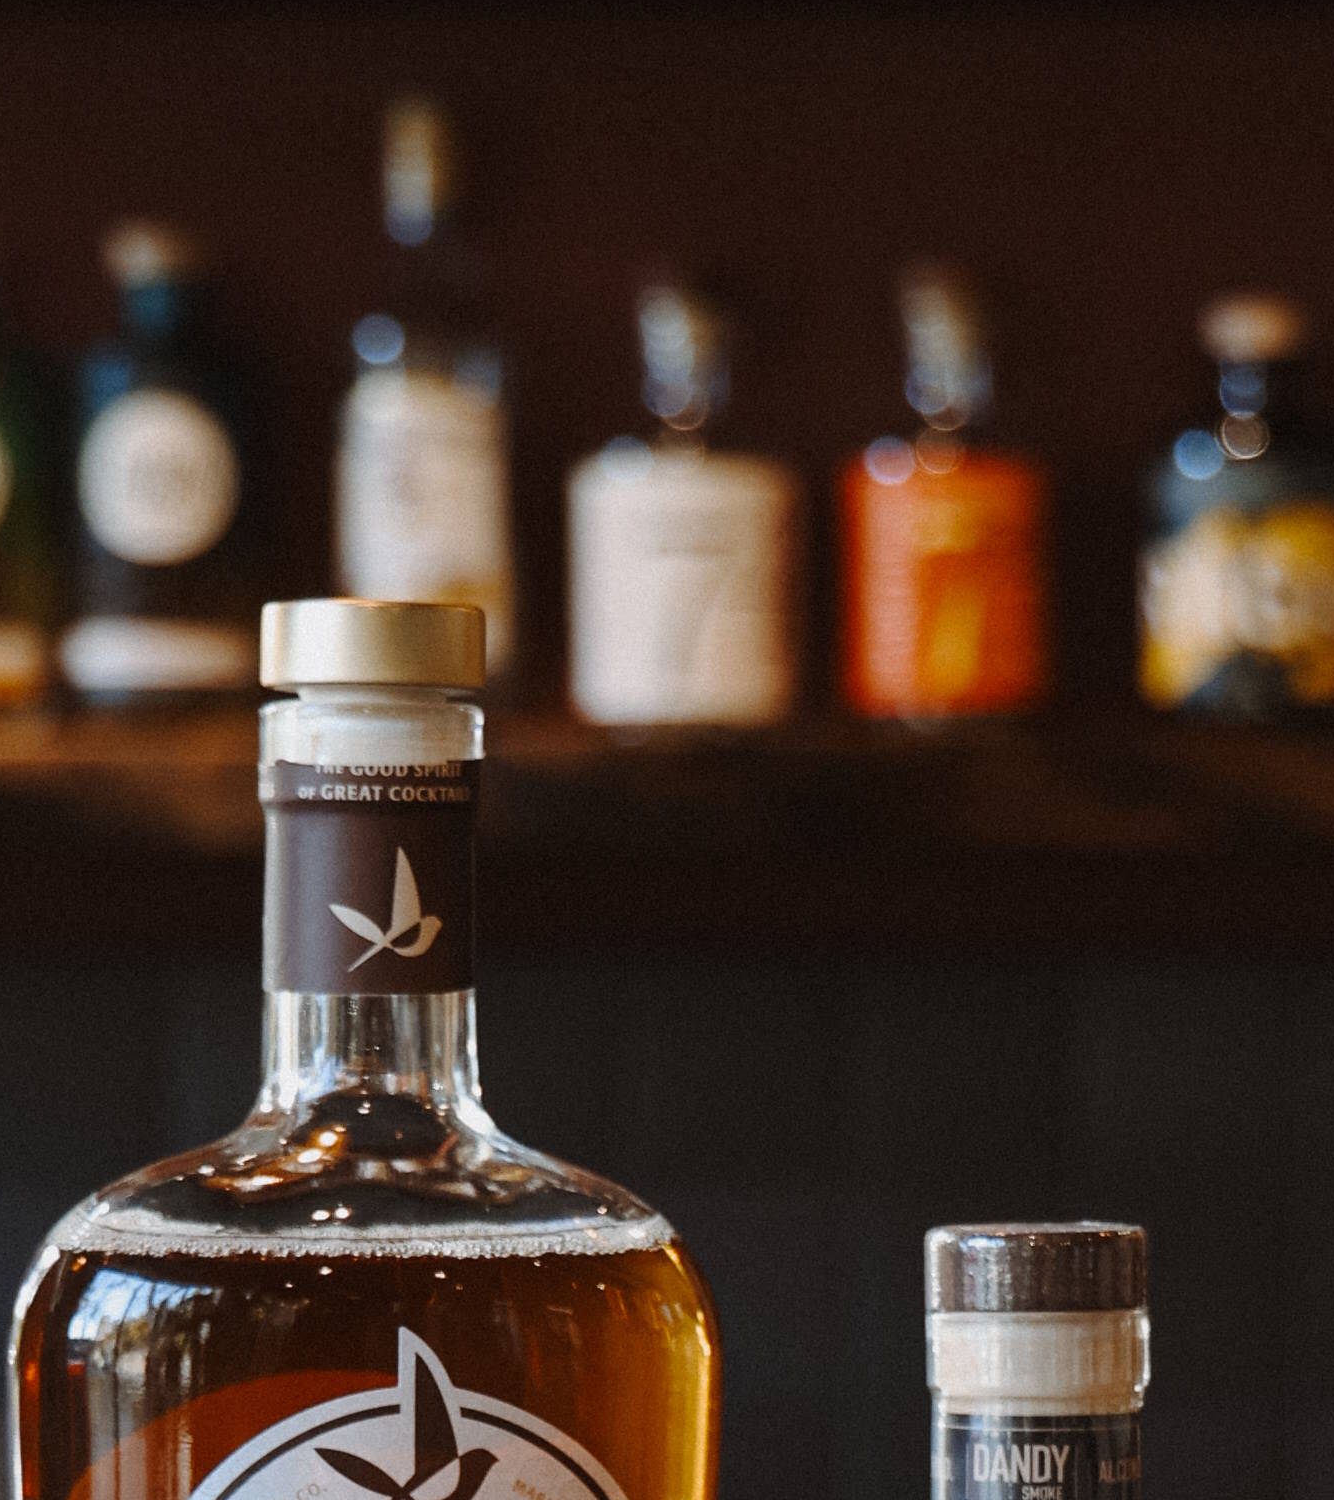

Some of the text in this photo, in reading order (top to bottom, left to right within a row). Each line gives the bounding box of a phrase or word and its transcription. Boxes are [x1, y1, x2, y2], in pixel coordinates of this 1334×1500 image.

[297, 786, 316, 800] OF
[321, 784, 384, 801] GREAT
[972, 1443, 1070, 1484] DANDY
[1021, 1484, 1063, 1500] SMOKE
